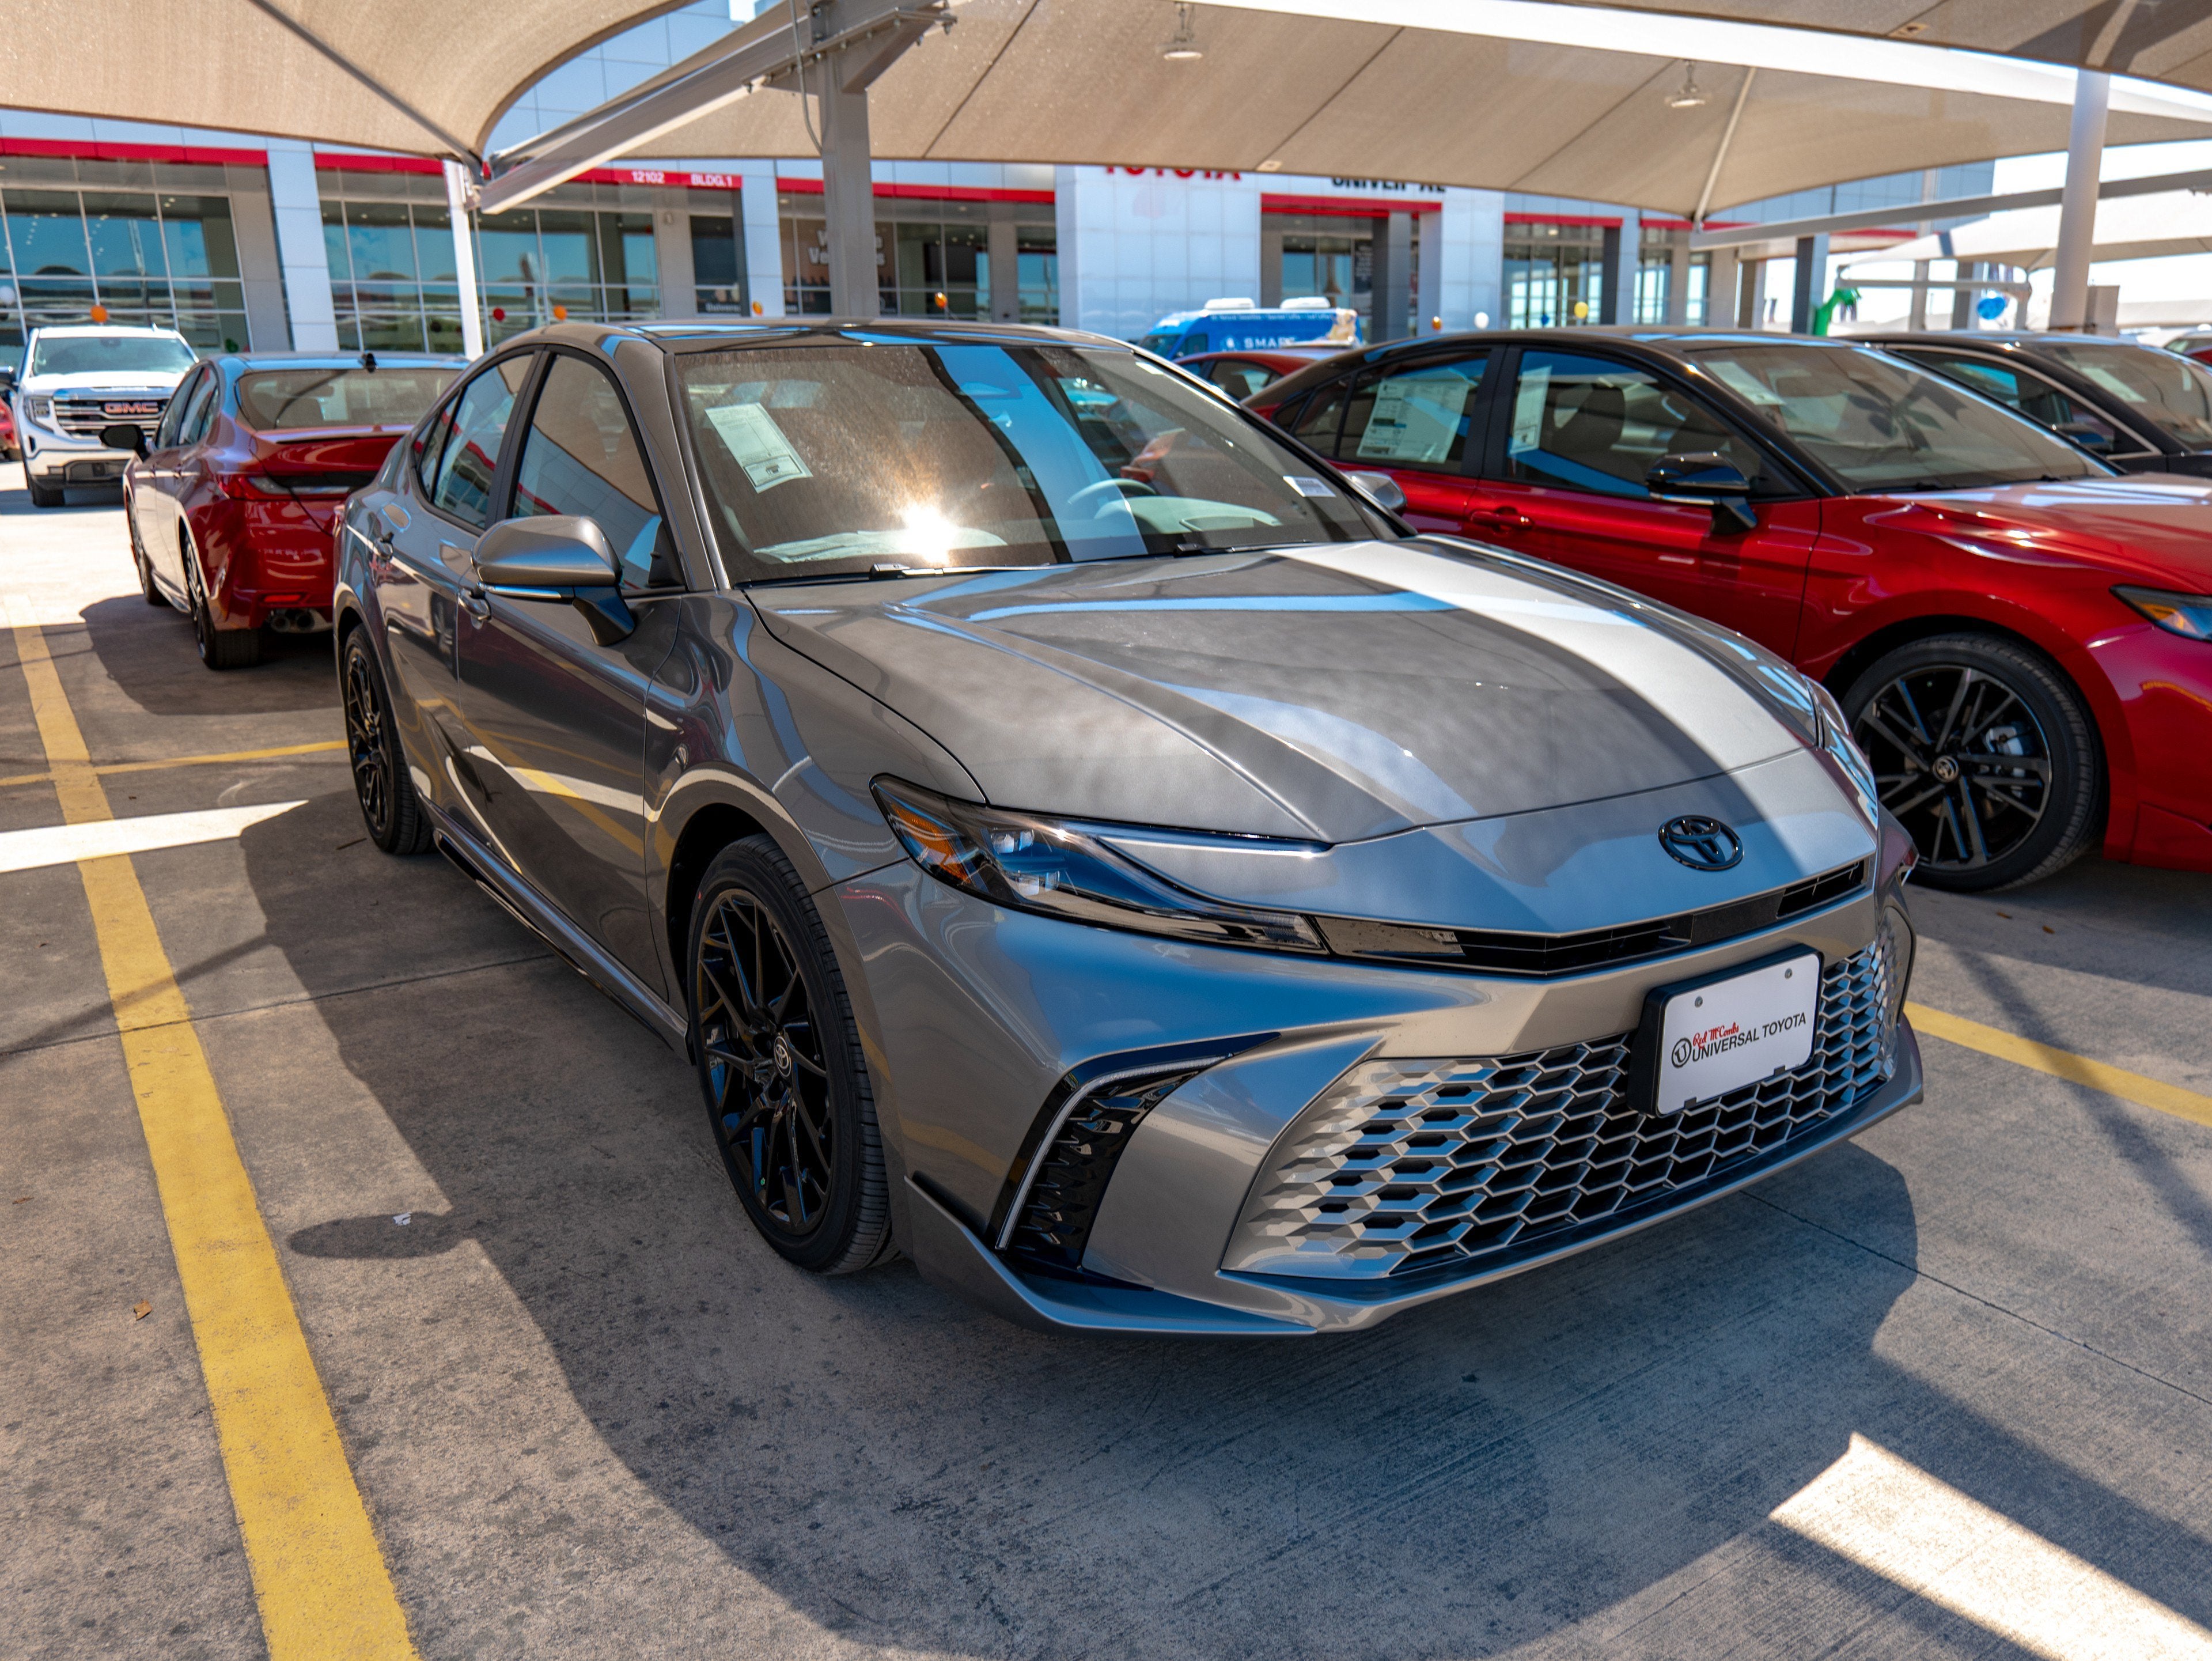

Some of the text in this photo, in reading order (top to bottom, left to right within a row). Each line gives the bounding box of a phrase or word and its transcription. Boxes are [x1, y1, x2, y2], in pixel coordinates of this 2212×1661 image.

[631, 171, 665, 184] 12102
[105, 402, 159, 414] GMC
[1692, 1012, 1806, 1062] UNIVERSAL TOYOTA
[1693, 1021, 1739, 1049] Red McCombs
